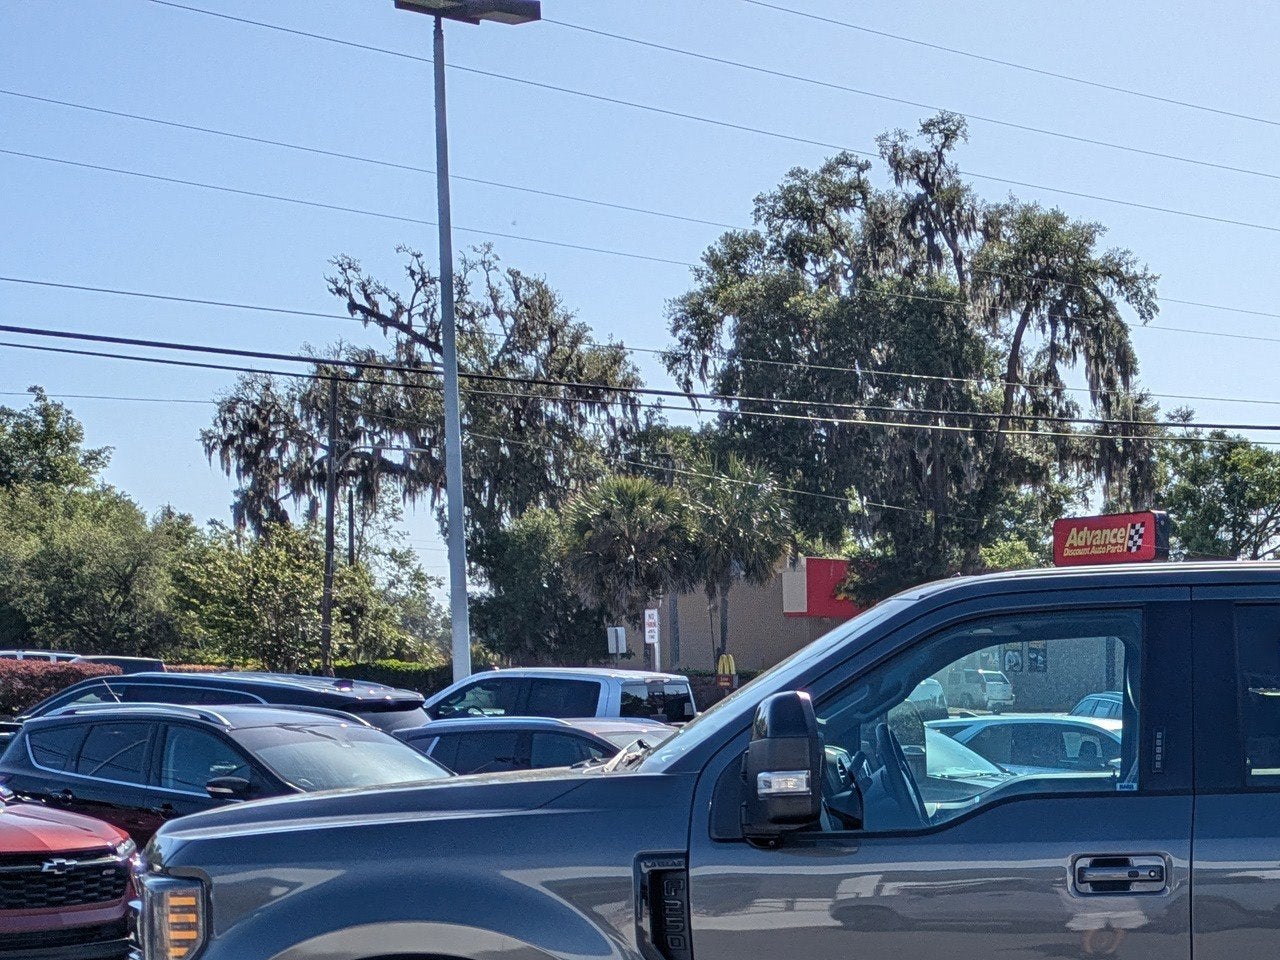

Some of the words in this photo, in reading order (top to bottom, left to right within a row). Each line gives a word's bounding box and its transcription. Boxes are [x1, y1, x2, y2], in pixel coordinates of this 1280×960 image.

[1065, 526, 1126, 547] Advance
[1063, 547, 1090, 556] Discount
[1090, 546, 1106, 555] Auto
[1106, 544, 1123, 554] Parts
